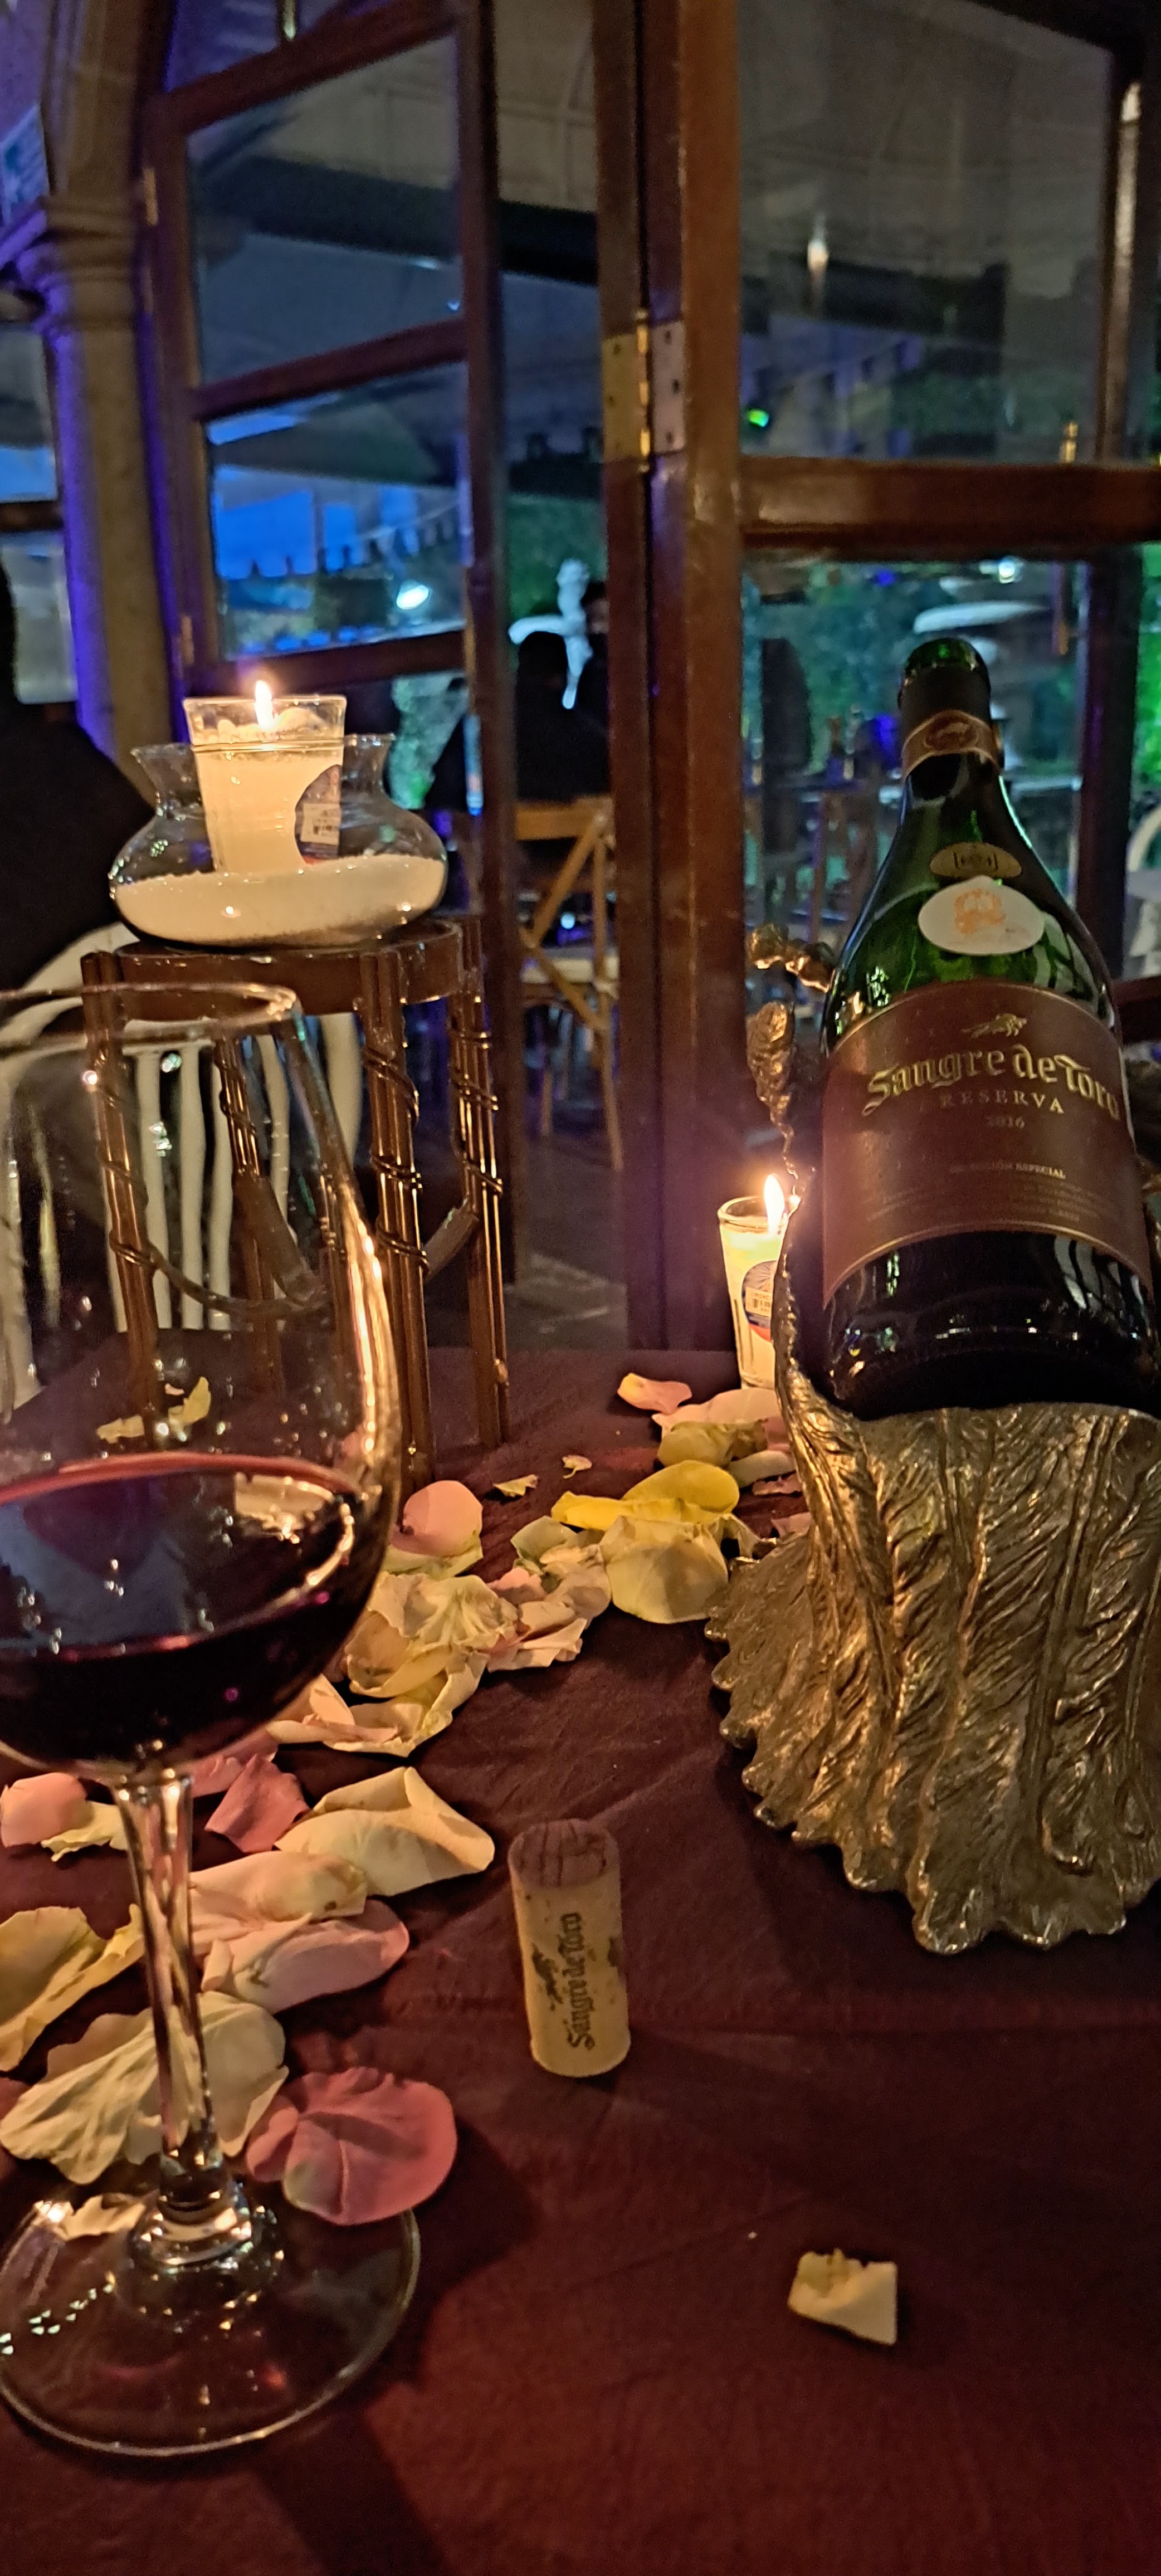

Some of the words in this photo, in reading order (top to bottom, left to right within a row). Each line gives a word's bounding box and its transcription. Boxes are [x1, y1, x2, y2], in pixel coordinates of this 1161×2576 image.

[861, 1050, 1005, 1116] Sangre
[1011, 1043, 1057, 1083] de
[1054, 1054, 1120, 1121] Toro
[940, 1089, 1064, 1114] RESERVA
[558, 1912, 584, 1957] Toro
[563, 1958, 584, 1978] de
[567, 1979, 595, 2050] Sangre
